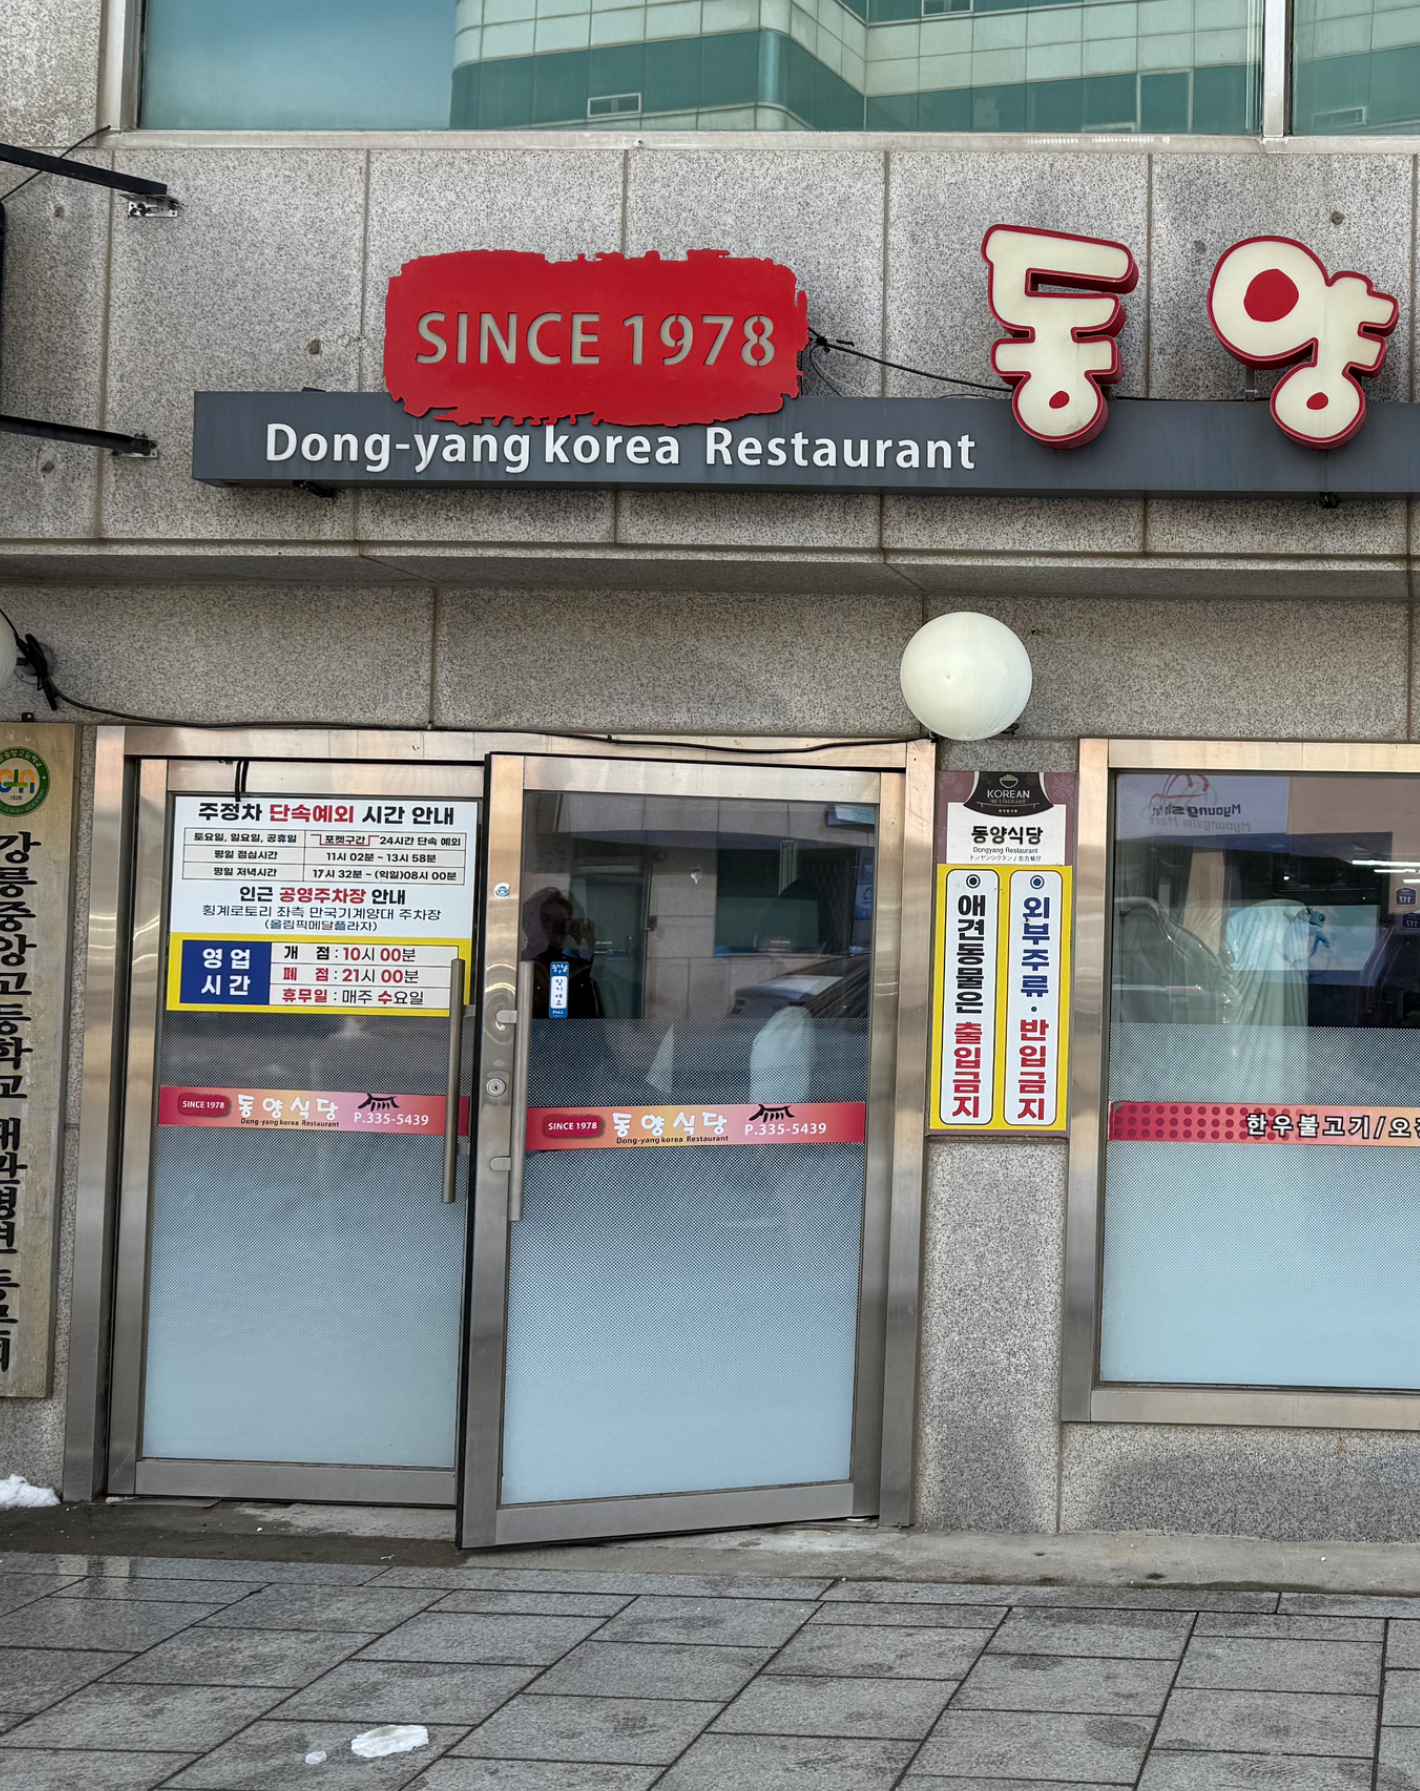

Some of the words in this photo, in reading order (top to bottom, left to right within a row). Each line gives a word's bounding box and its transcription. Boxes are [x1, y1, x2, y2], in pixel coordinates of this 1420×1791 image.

[415, 311, 599, 366] SINCE
[622, 313, 777, 369] 1978
[266, 422, 530, 473] Dong-yang
[544, 424, 680, 466] korea
[705, 426, 977, 470] Restaurant
[987, 789, 1030, 799] KOREAN
[199, 802, 262, 821] 주정차
[269, 804, 354, 823] 단속예외
[362, 806, 405, 824] 시간
[412, 807, 454, 825] 안내
[267, 834, 297, 843] 공휴일
[380, 836, 414, 846] 24시간
[417, 837, 437, 846] 단속
[441, 837, 461, 846] 예외
[971, 826, 1044, 845] 동양식당
[214, 850, 234, 859] 평일
[237, 850, 278, 860] 점심시간
[326, 852, 346, 862] 11시
[350, 852, 374, 862] 02분
[387, 853, 408, 863] 13시
[412, 854, 436, 863] 58분
[973, 846, 1003, 854] Dongyang
[214, 867, 233, 876] 평일
[237, 867, 277, 877] 저녁시간
[313, 869, 334, 879] 17시
[338, 870, 362, 879] 32분
[432, 871, 457, 881] 00분
[239, 886, 273, 902] 인근
[279, 887, 366, 904] 공영주차장
[372, 889, 405, 905] 안내
[277, 906, 305, 918] 좌측
[310, 907, 394, 920] 만국기계양대
[399, 909, 441, 921] 주차장
[342, 947, 375, 962] 10시
[380, 948, 416, 962] 00분
[955, 894, 986, 1014] 애견동물은
[342, 969, 375, 984] 21시
[381, 969, 419, 984] 00분
[282, 988, 328, 1003] 휴무일
[342, 990, 373, 1005] 매주
[377, 990, 424, 1006] 수요일
[952, 1021, 983, 1119] 출입금지
[1018, 1018, 1049, 1121] 반입금지
[182, 1100, 205, 1109] SINCE
[206, 1101, 225, 1109] 1978
[237, 1094, 338, 1120] 동양식당
[354, 1112, 429, 1126] P.335-5439
[548, 1121, 574, 1131] SINCE
[576, 1121, 597, 1131] 1978
[612, 1112, 727, 1137] 동양식당
[744, 1122, 827, 1136] P.335-5439
